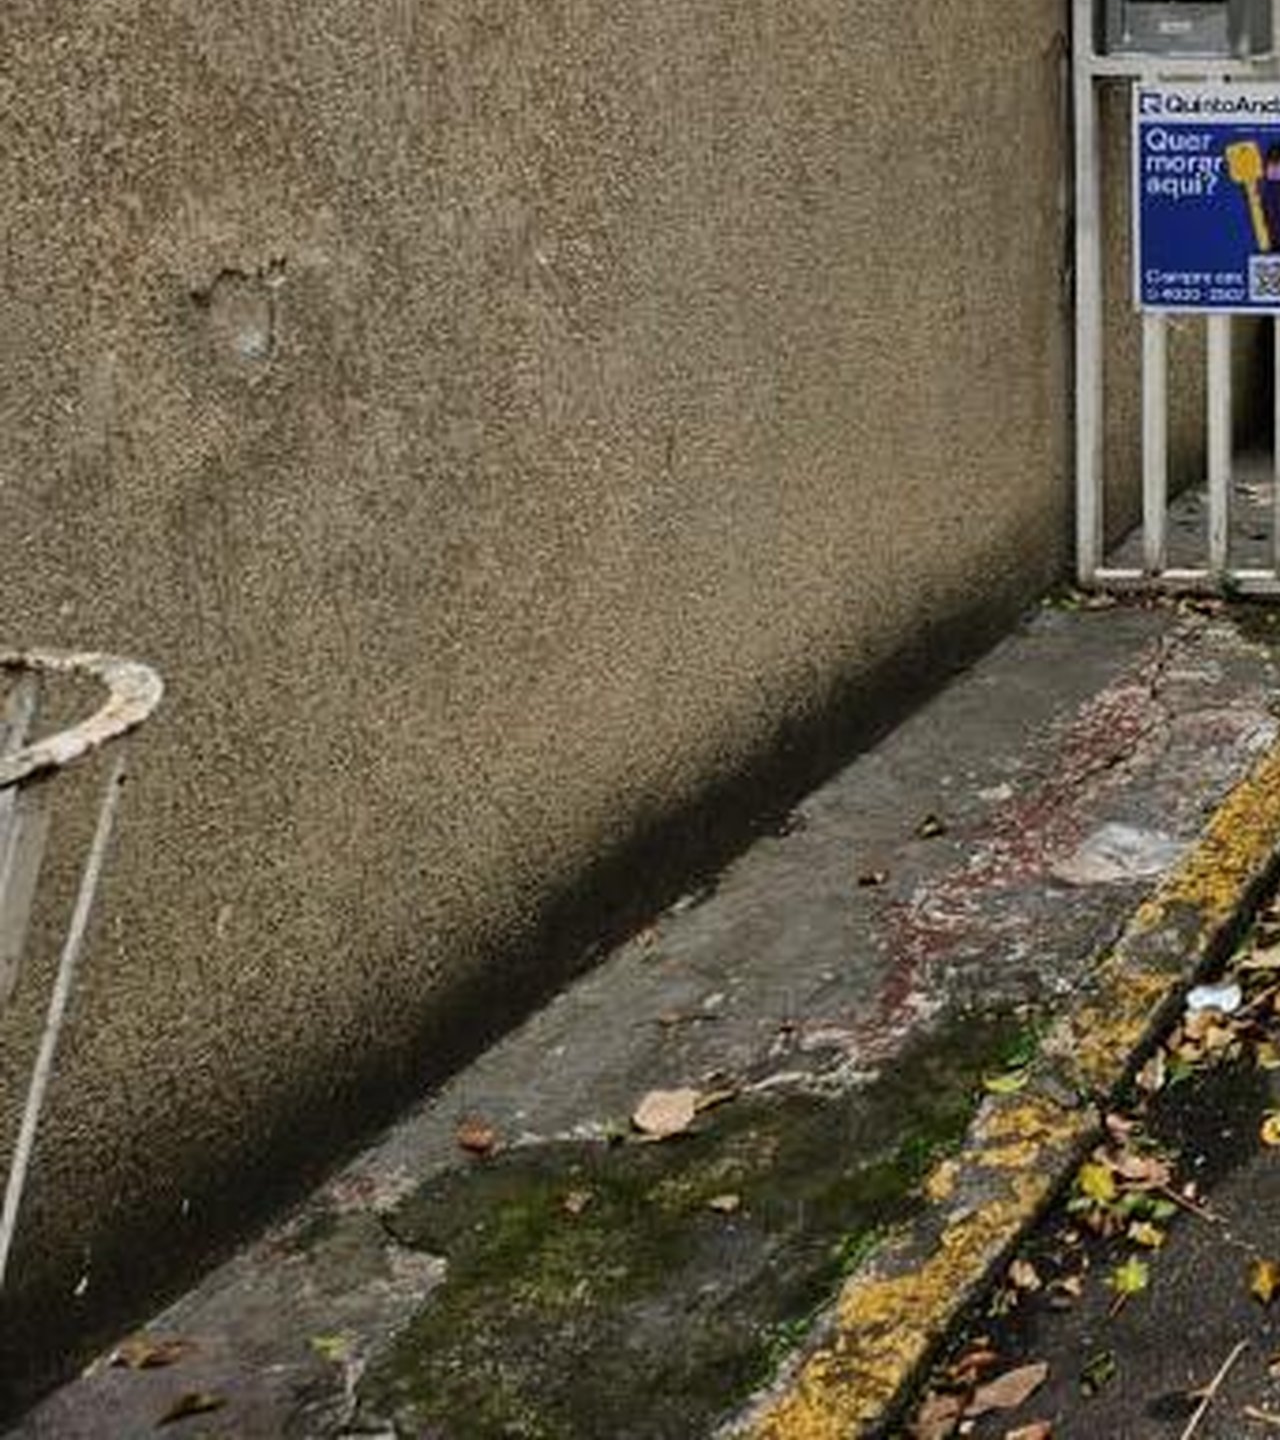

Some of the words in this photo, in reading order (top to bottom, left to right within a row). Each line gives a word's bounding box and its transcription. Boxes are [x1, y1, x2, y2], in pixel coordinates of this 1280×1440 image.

[1145, 127, 1213, 152] Quer
[1145, 156, 1224, 173] morar
[1146, 173, 1219, 200] aqui?
